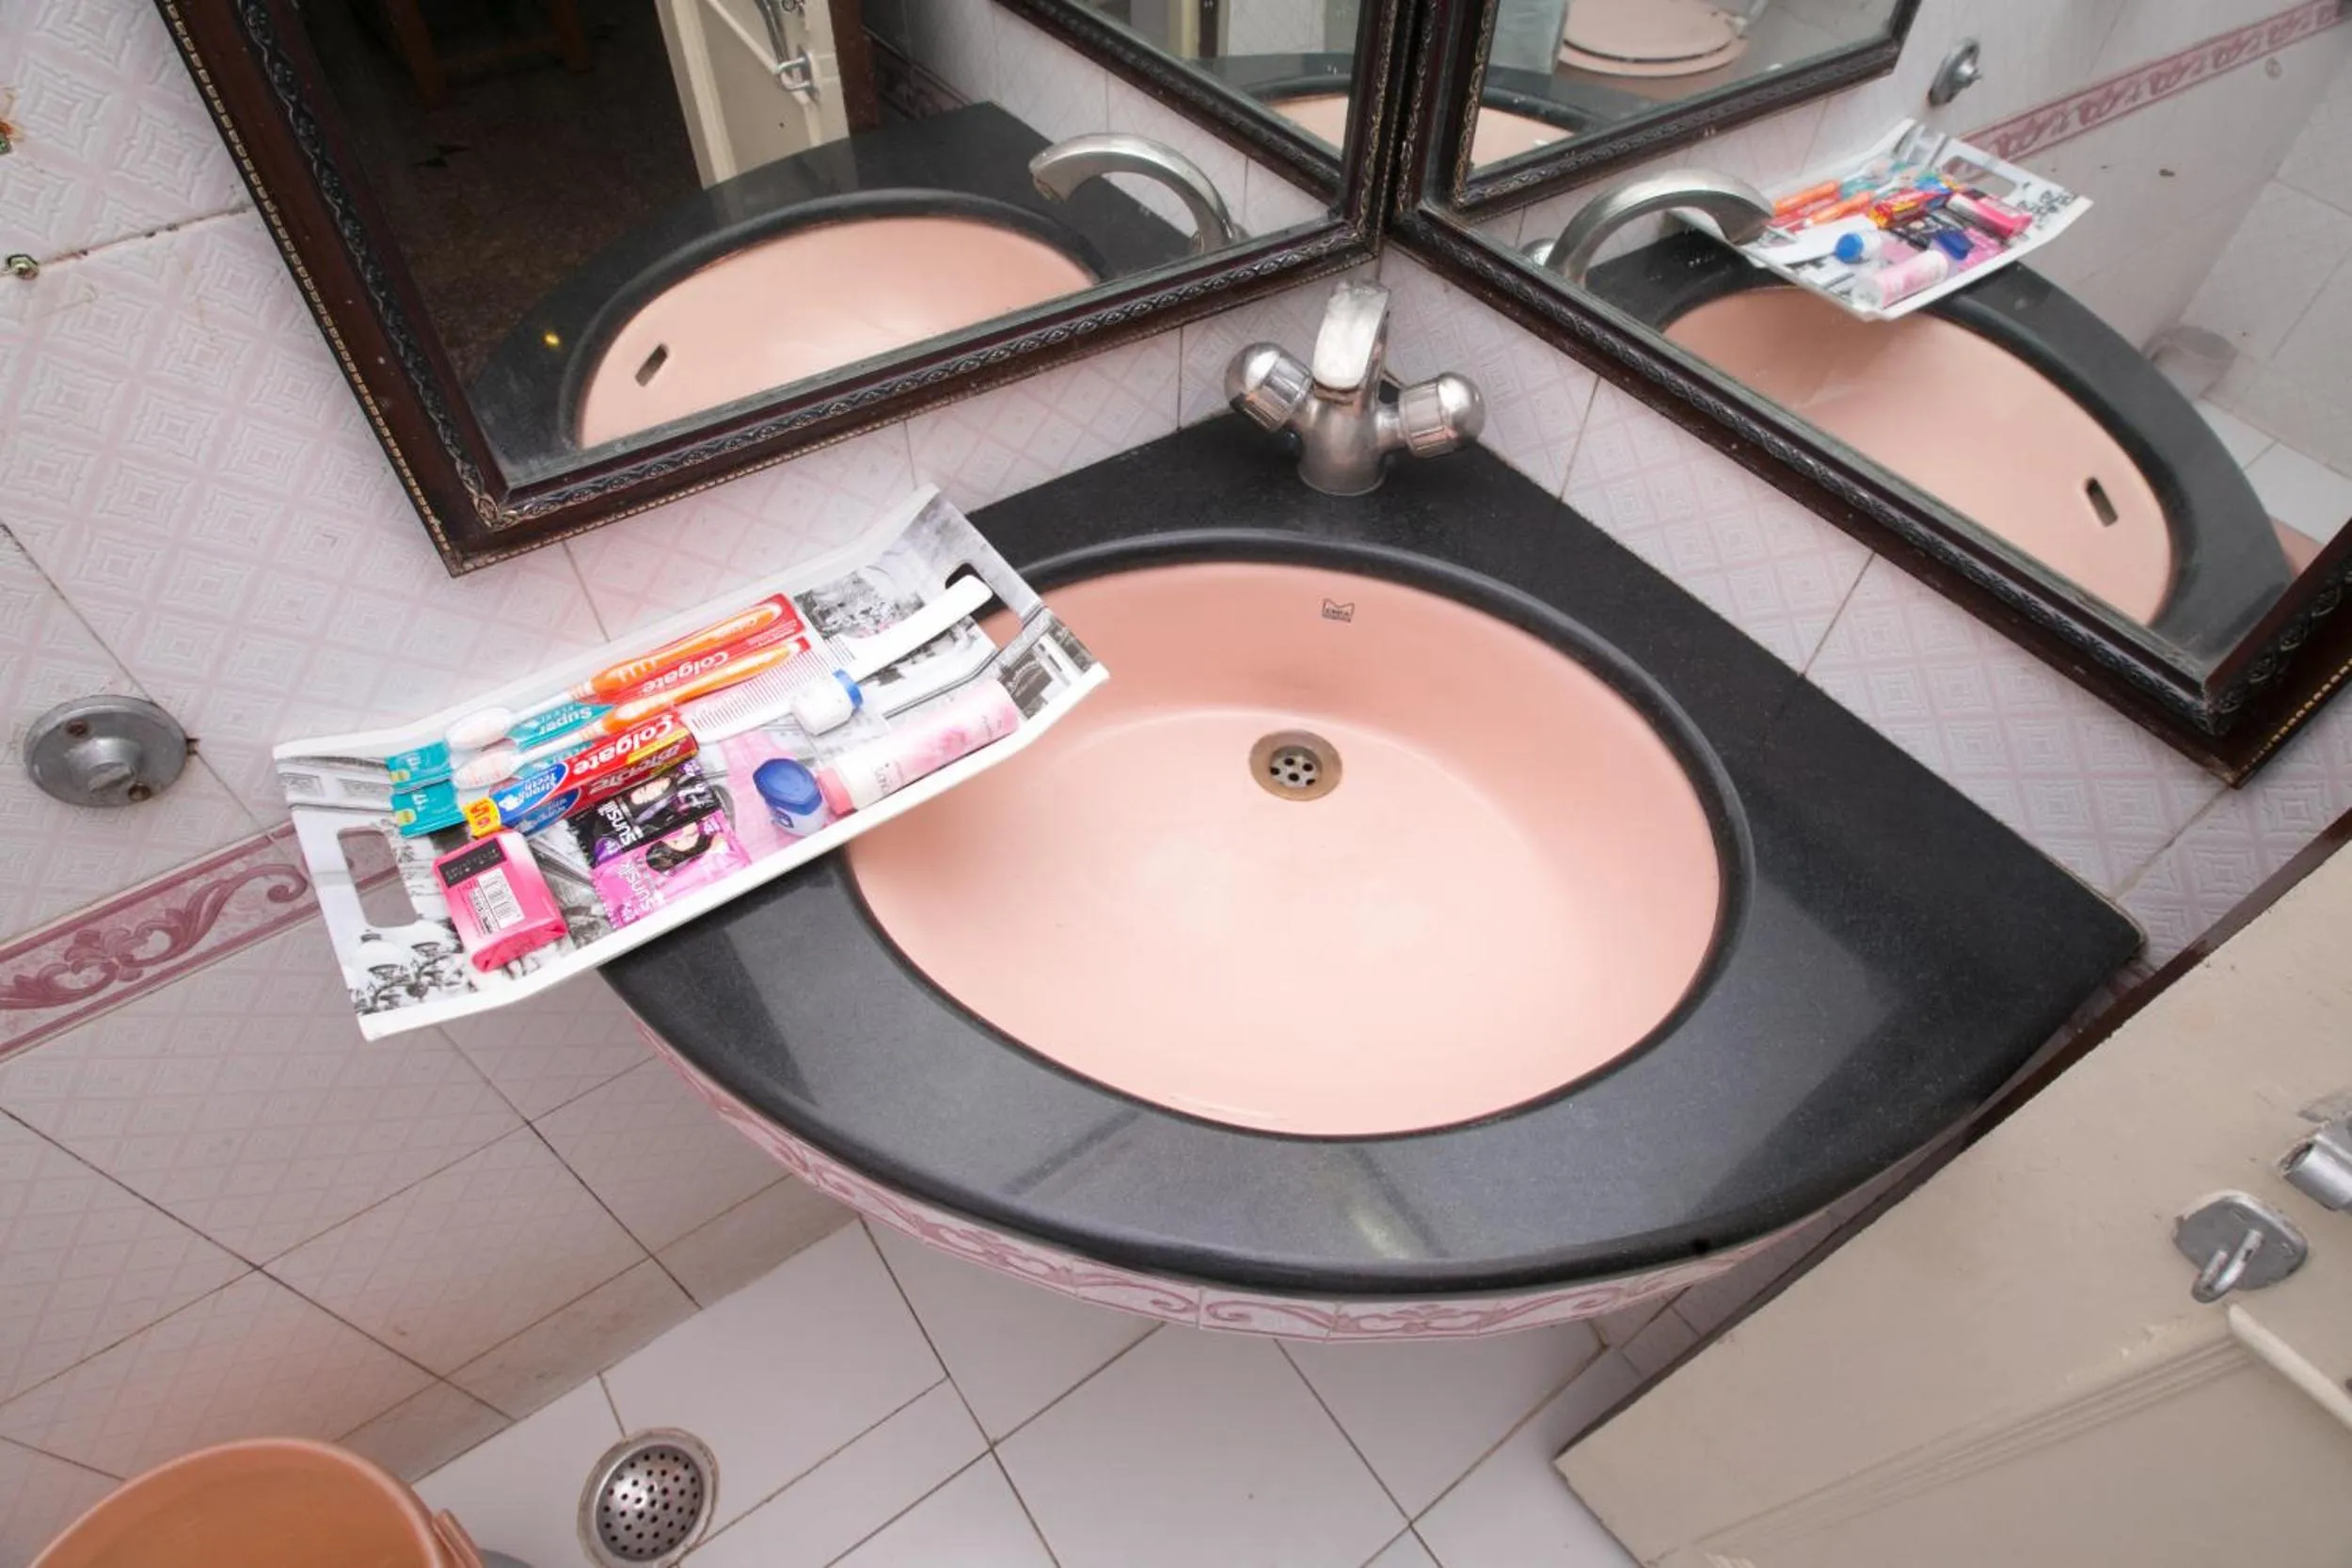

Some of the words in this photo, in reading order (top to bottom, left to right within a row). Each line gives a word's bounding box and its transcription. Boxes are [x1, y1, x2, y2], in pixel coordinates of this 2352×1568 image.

[642, 650, 729, 693] Colgate
[537, 706, 593, 734] Super
[573, 714, 674, 775] Colgate
